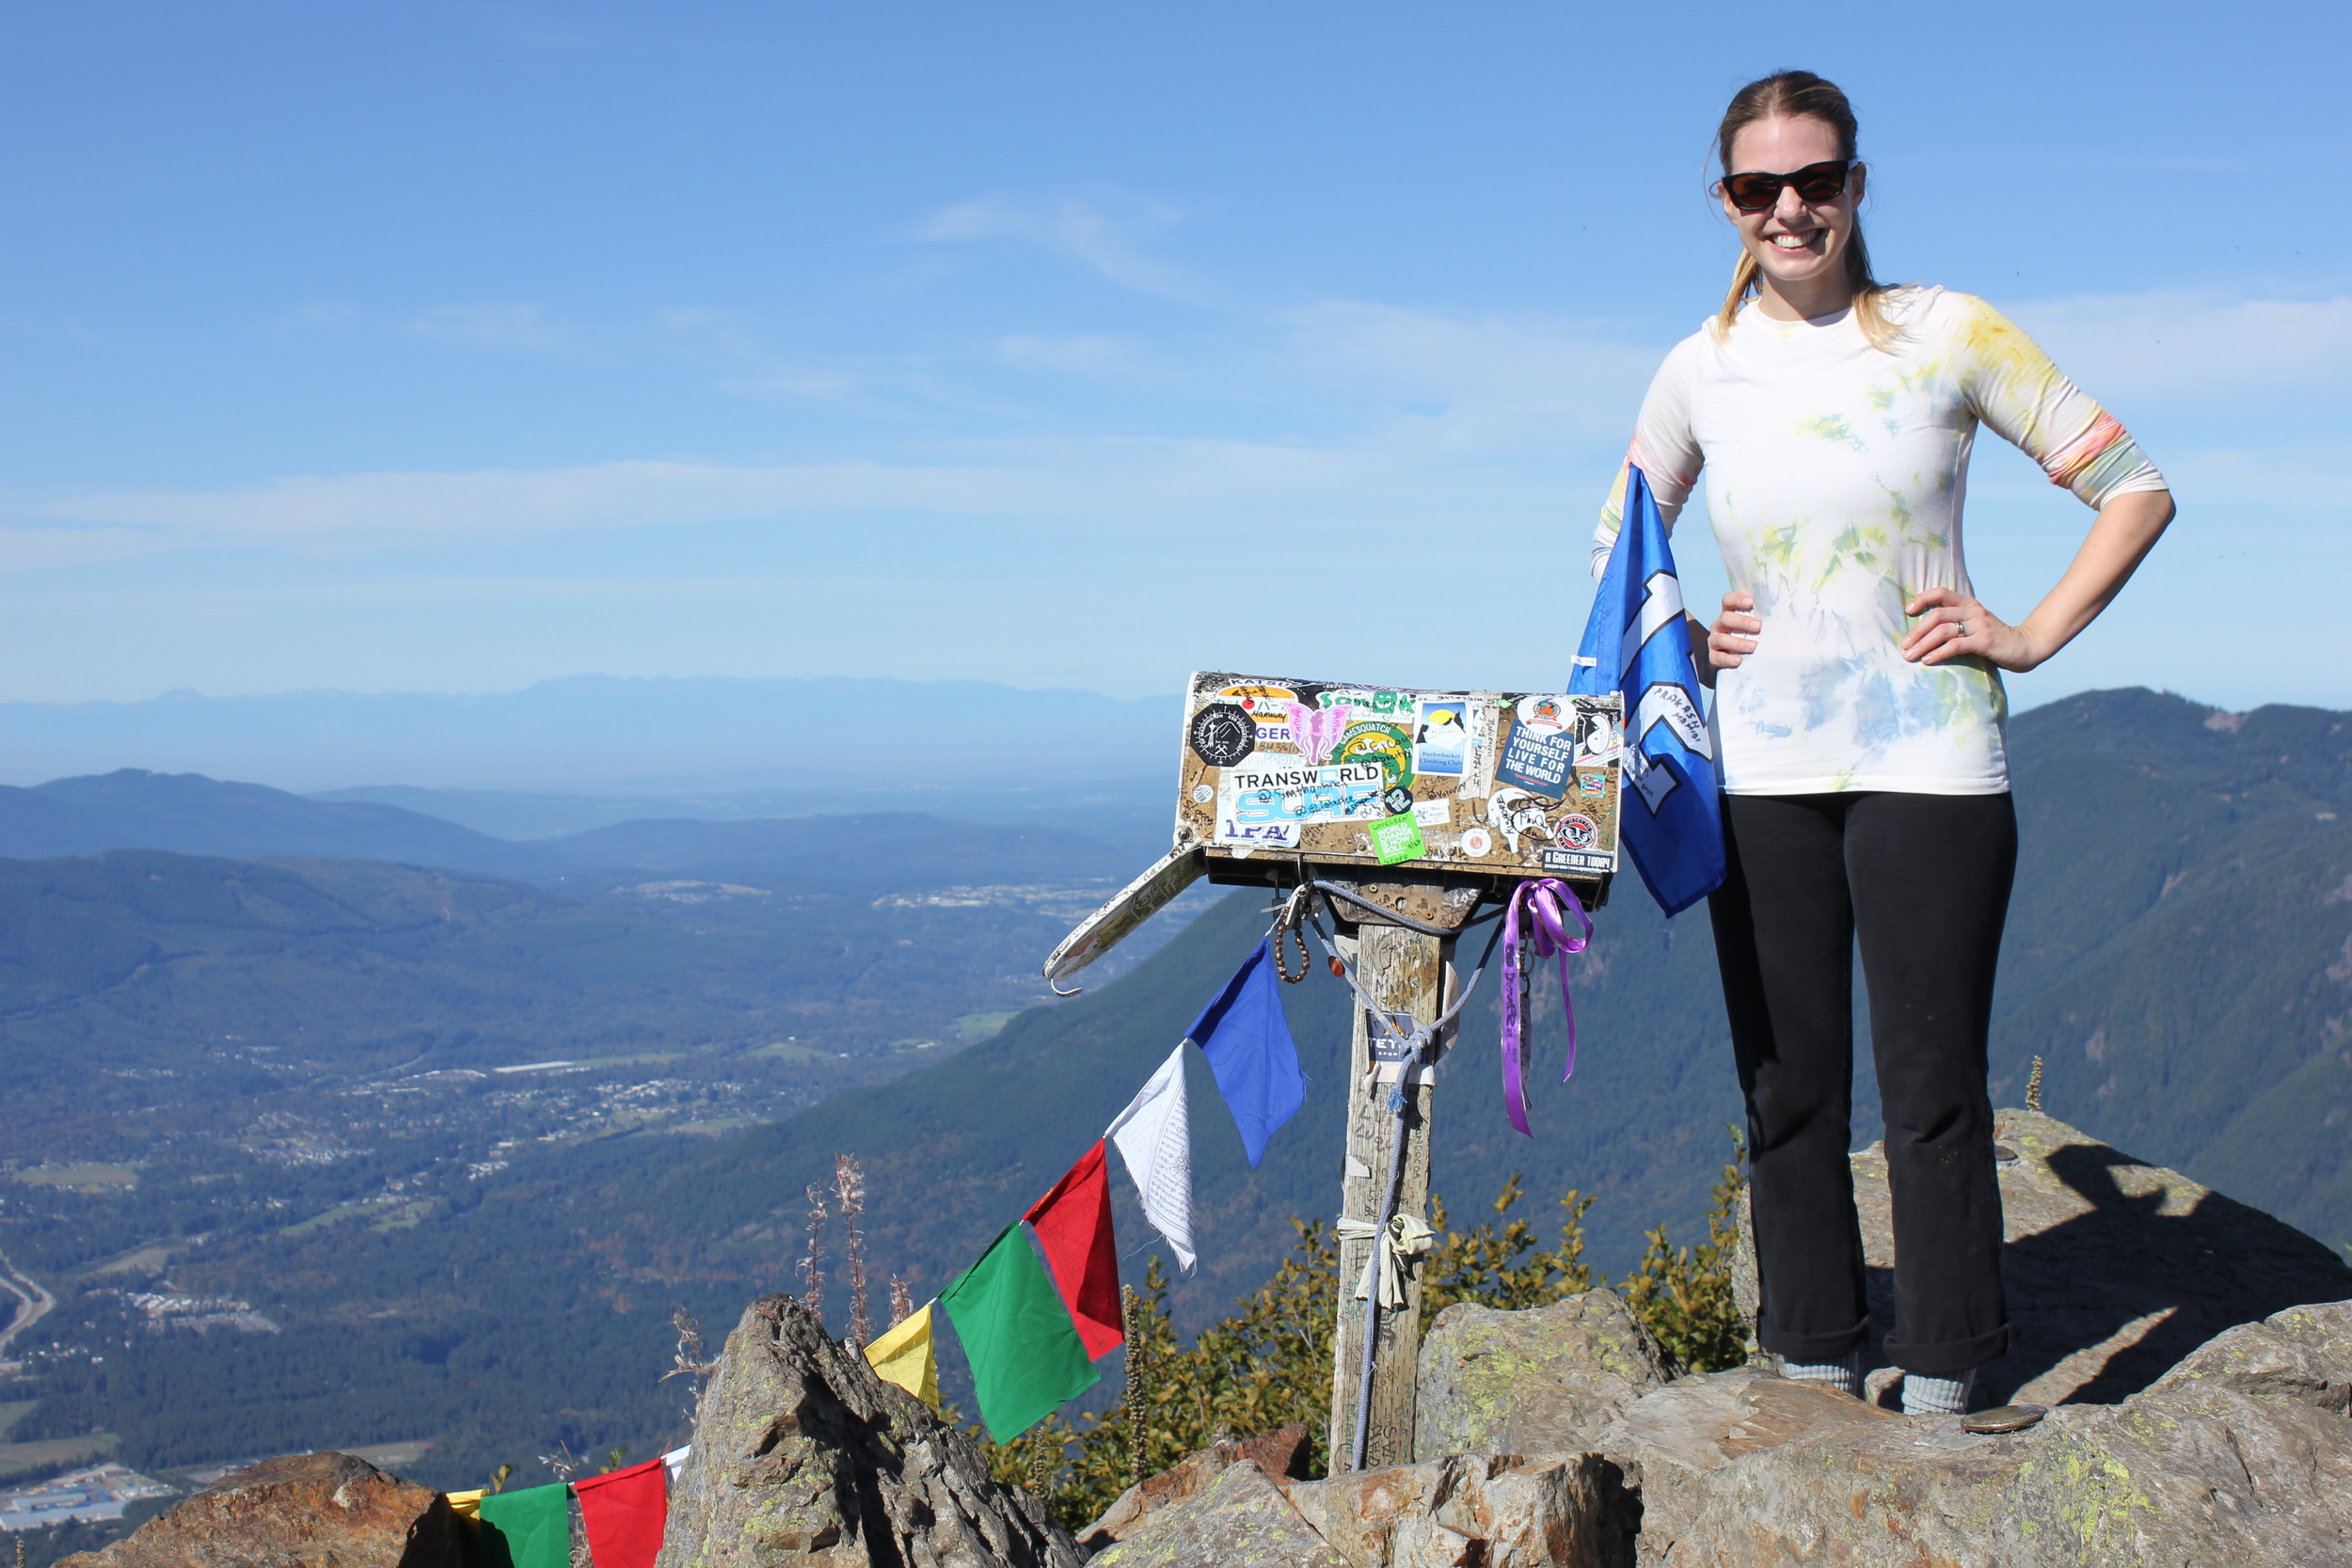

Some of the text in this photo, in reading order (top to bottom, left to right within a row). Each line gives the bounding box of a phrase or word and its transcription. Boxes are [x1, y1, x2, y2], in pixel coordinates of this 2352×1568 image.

[1339, 723, 1391, 744] GAMESQUATCH
[1516, 726, 1548, 745] THINK
[1549, 736, 1572, 752] FOR
[1513, 736, 1569, 761] YOURSELF
[1420, 757, 1447, 766] Climbing
[1507, 747, 1565, 774] LIVE FOR
[1505, 758, 1526, 773] THE
[1525, 764, 1562, 784] WORLD
[1236, 782, 1380, 825] SURF
[1386, 788, 1411, 813] 12
[1376, 822, 1408, 836] WORLD
[1565, 817, 1593, 832] WISCONSIN
[1379, 828, 1413, 843] CHANGE
[1390, 835, 1411, 847] HOW
[1383, 846, 1407, 855] ROLL
[1545, 851, 1551, 863] A
[1586, 855, 1611, 869] TODAY
